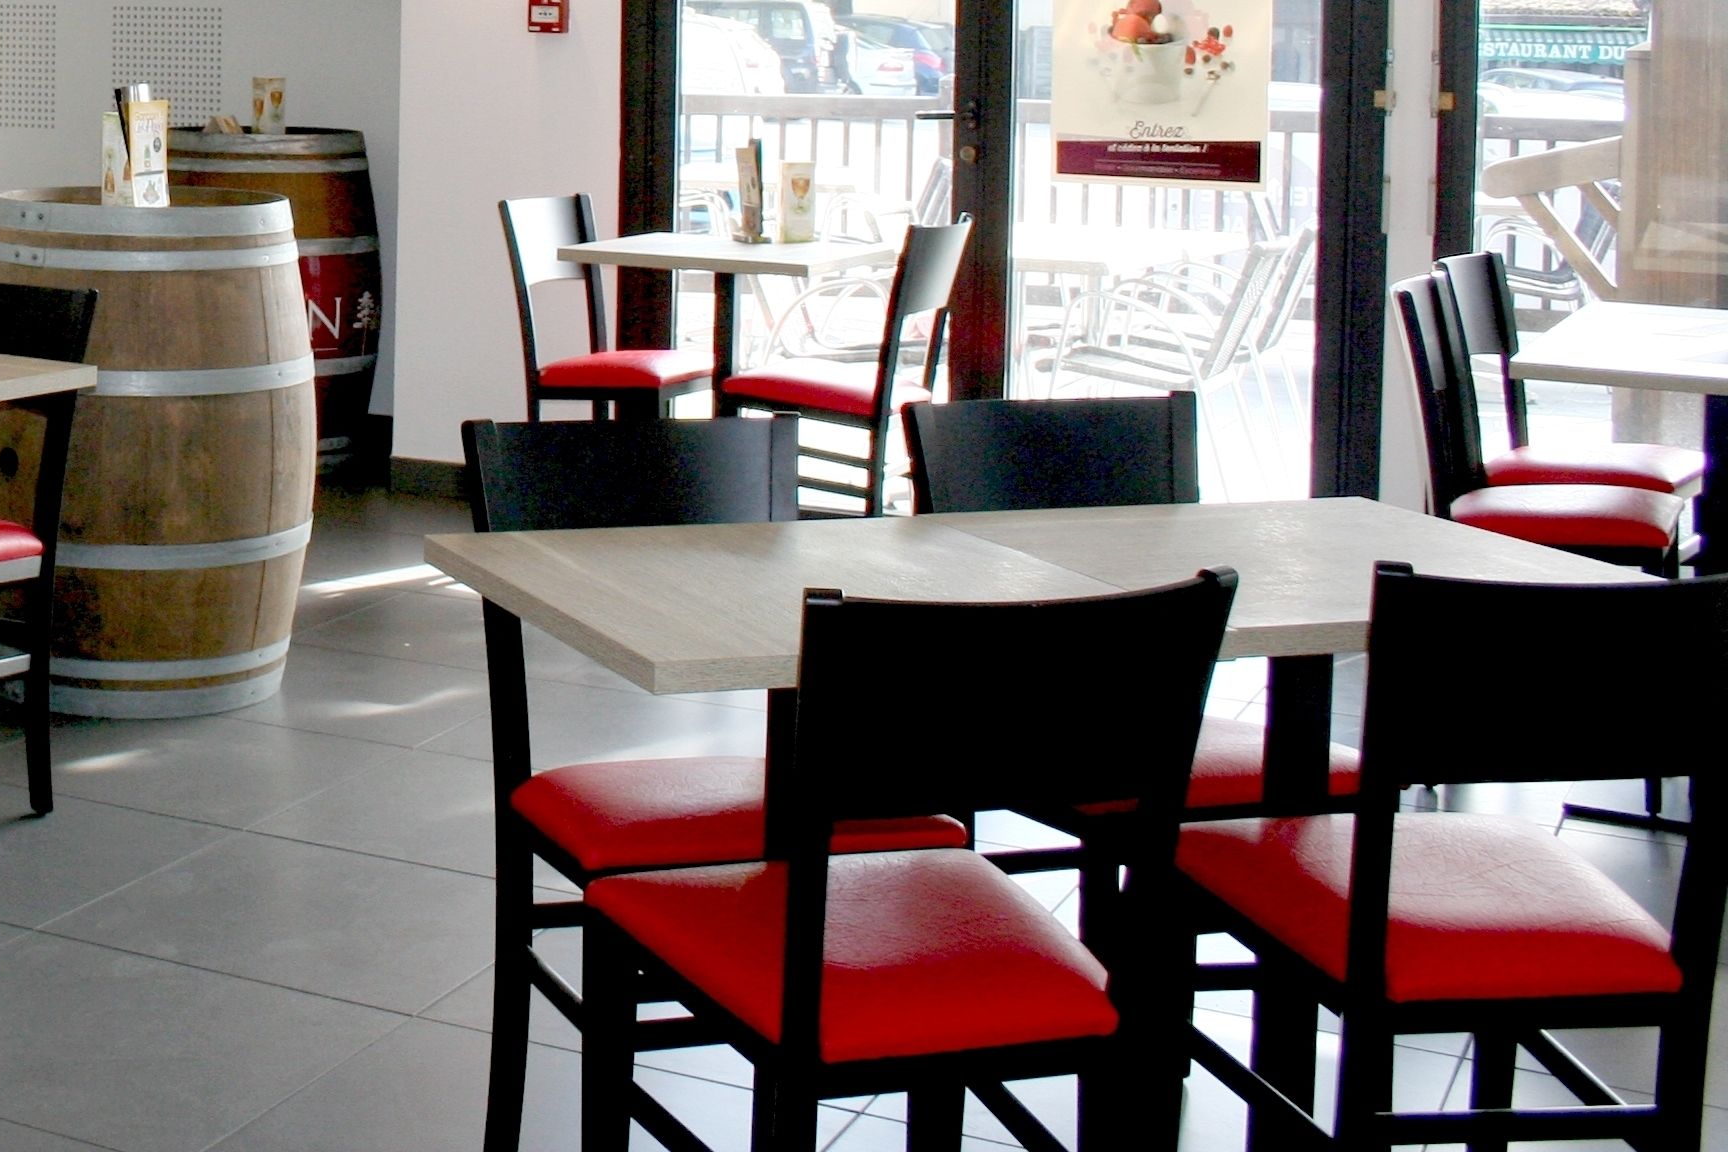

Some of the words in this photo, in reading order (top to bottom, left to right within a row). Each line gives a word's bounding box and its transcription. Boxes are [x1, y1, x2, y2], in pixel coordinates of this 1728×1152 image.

[1480, 42, 1592, 59] STAURANT
[1598, 45, 1625, 60] DU
[1129, 120, 1184, 139] Entrez
